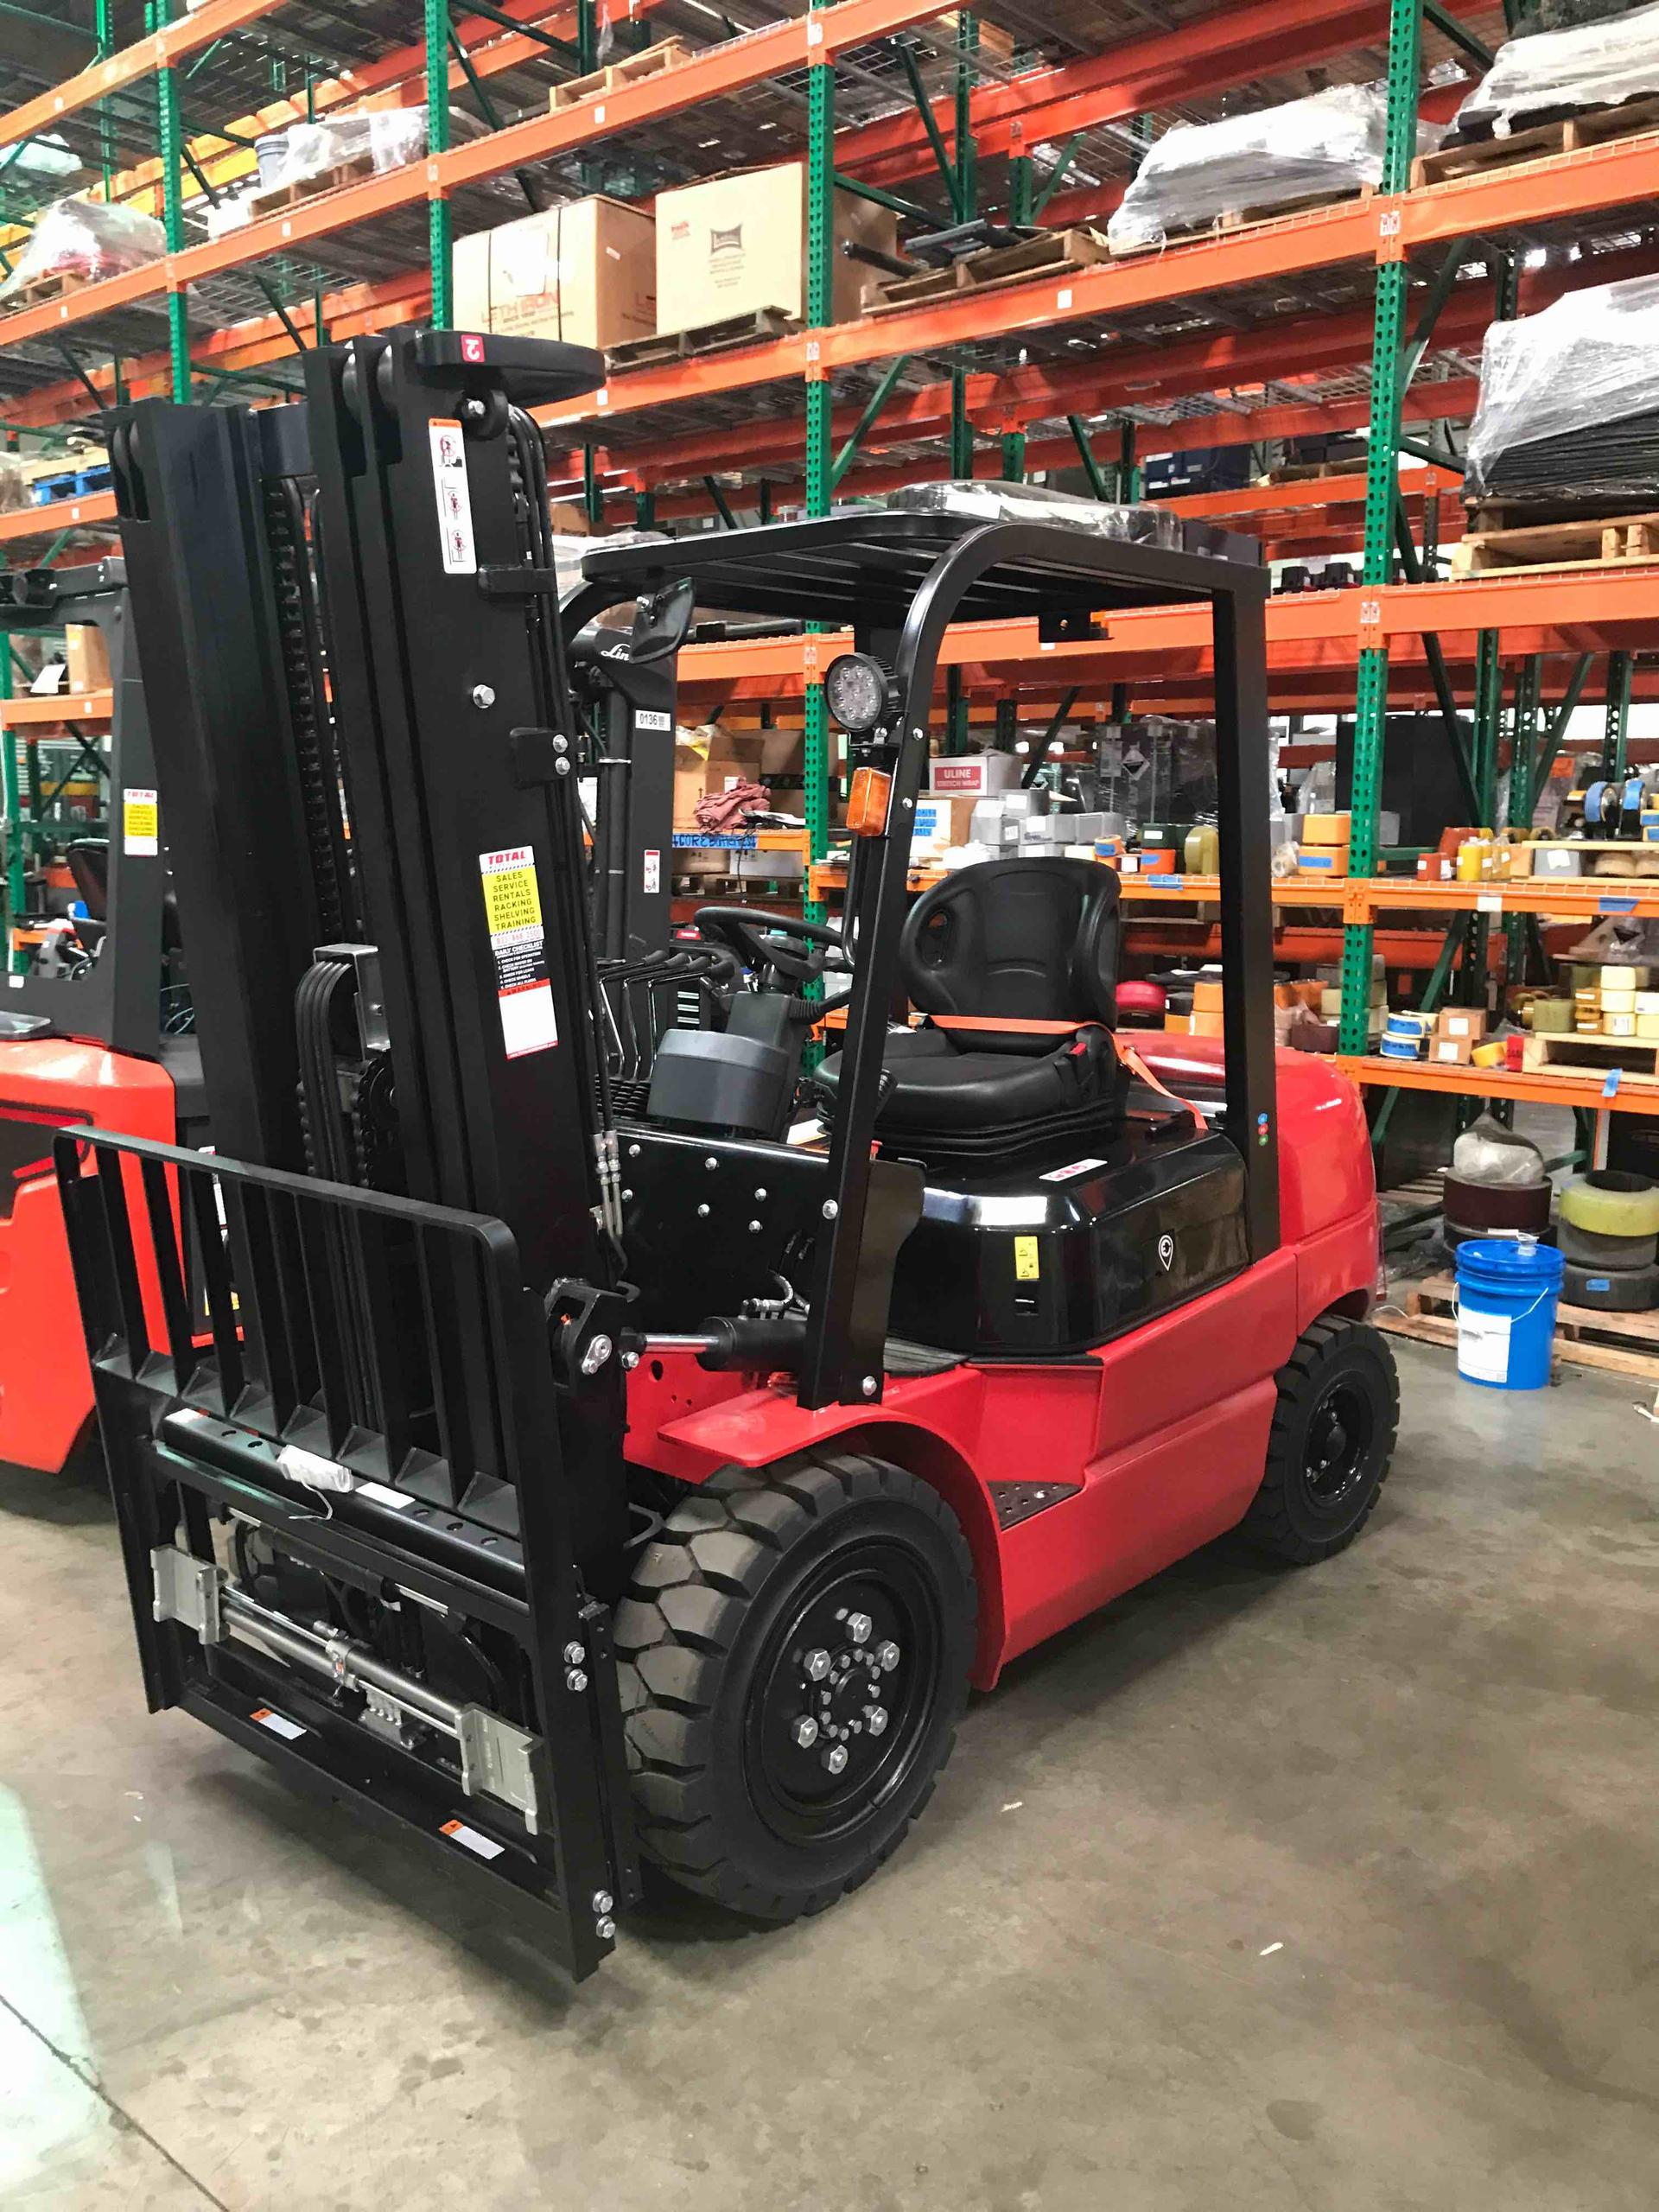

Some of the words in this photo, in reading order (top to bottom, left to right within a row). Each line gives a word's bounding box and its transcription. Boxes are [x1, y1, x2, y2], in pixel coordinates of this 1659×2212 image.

[601, 643, 631, 661] Lin
[639, 713, 658, 726] 0136
[944, 768, 972, 779] ULINE
[488, 850, 526, 865] TOTAL
[496, 871, 523, 882] SALES
[493, 880, 529, 893] SERVICE
[493, 888, 531, 902] RENTALS
[494, 899, 532, 912] RACKING
[494, 907, 535, 921] SHELVING
[495, 916, 536, 931] TRAINING
[495, 947, 511, 957] DAILY
[512, 940, 543, 952] CHECKLIST
